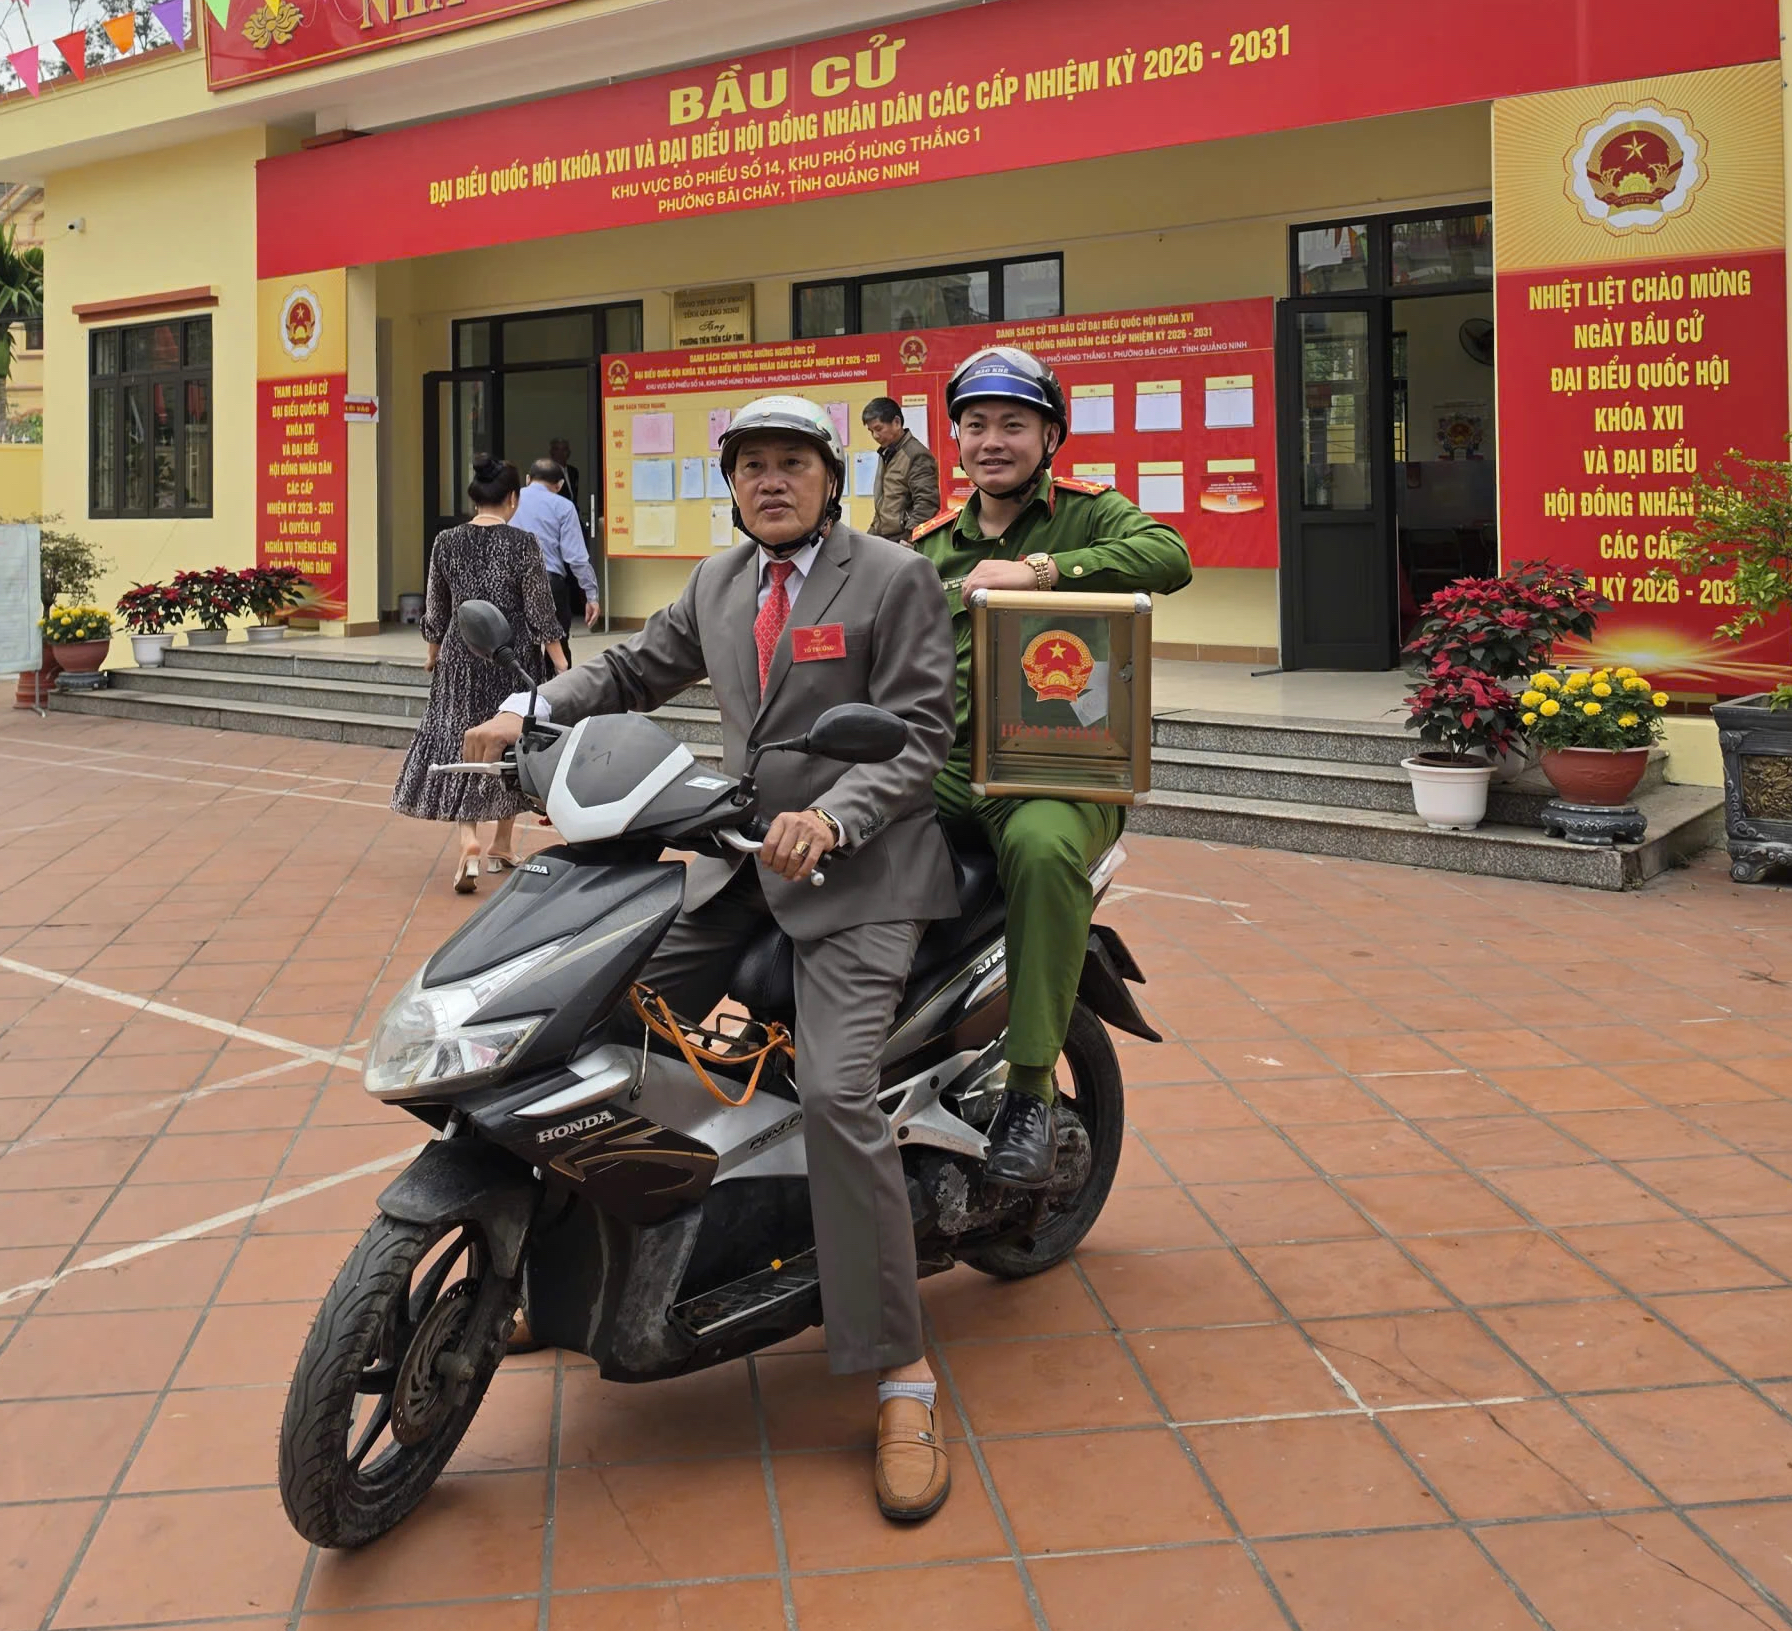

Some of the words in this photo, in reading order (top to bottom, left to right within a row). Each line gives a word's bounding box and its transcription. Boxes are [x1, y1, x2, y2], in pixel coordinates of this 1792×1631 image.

[670, 64, 787, 126] BẦU
[811, 33, 906, 98] CỬ
[429, 179, 452, 208] ĐẠI
[455, 165, 487, 200] BIỂU
[490, 158, 528, 196] QUỐC
[532, 156, 557, 190] HỘI
[561, 149, 601, 182] KHÓA
[605, 147, 630, 174] XVI
[634, 138, 655, 169] VÀ
[659, 137, 687, 169] ĐẠI
[691, 121, 729, 160] BIỂU
[734, 119, 763, 156] HỘI
[768, 109, 817, 147] ĐỒNG
[823, 100, 876, 137] NHÂN
[881, 91, 922, 127] DÂN
[928, 82, 969, 118] CÁC
[976, 68, 1018, 110] CẤP
[1025, 58, 1099, 101] NHIỆM
[1106, 48, 1137, 87] KỲ
[1143, 41, 1203, 81] 2026
[1211, 51, 1221, 60] -
[1228, 24, 1290, 66] 2031
[611, 182, 639, 200] KHU
[641, 177, 670, 197] VỰC
[673, 169, 693, 190] BỎ
[696, 162, 737, 187] PHIẾU
[740, 157, 761, 180] SỐ
[764, 160, 785, 176] 14,
[788, 153, 820, 173] KHU
[823, 140, 856, 167] PHỐ
[860, 139, 906, 161] HÙNG
[909, 125, 970, 152] THẮNG
[973, 126, 980, 142] 1
[658, 191, 714, 213] PHƯỜNG
[717, 186, 740, 205] BÃI
[742, 180, 785, 201] CHÁY,
[788, 174, 821, 194] TỈNH
[824, 165, 879, 189] QUẢNG
[882, 160, 920, 180] NINH
[1528, 279, 1582, 313] NHIỆT
[1587, 275, 1626, 310] LIỆT
[1631, 271, 1684, 303] CHÀO
[1690, 267, 1751, 299] MỪNG
[995, 328, 1015, 339] DANH
[1016, 325, 1035, 337] SÁCH
[1036, 323, 1047, 335] CỬ
[1048, 324, 1059, 334] TRI
[1060, 319, 1075, 333] BẦU
[1076, 319, 1087, 331] CỬ
[1088, 320, 1101, 333] ĐẠI
[1102, 316, 1119, 329] BIỂU
[1121, 314, 1141, 329] QUỐC
[1143, 314, 1156, 328] HỘI
[1158, 312, 1179, 325] KHÓA
[1181, 312, 1194, 323] XVI
[1574, 317, 1625, 349] NGÀY
[1630, 311, 1670, 346] BẦU
[1676, 308, 1705, 343] CỬ
[1550, 367, 1582, 396] ĐẠI
[1587, 354, 1631, 390] BIỂU
[1637, 353, 1690, 391] QUỐC
[1695, 354, 1730, 390] HỘI
[1594, 401, 1647, 432] KHÓA
[1652, 405, 1684, 431] XVI
[1583, 445, 1609, 475] VÀ
[1613, 449, 1646, 479] ĐẠI
[1652, 438, 1697, 473] BIỂU
[1544, 487, 1575, 522] HỘI
[1580, 484, 1633, 517] ĐỒNG
[1639, 486, 1694, 517] NHÂN
[1600, 529, 1639, 561] CÁC
[1602, 572, 1626, 601] KỲ
[1632, 578, 1680, 603] 2026
[1700, 579, 1742, 605] 203
[1001, 719, 1049, 739] HÒM
[537, 1110, 613, 1143] HONDA
